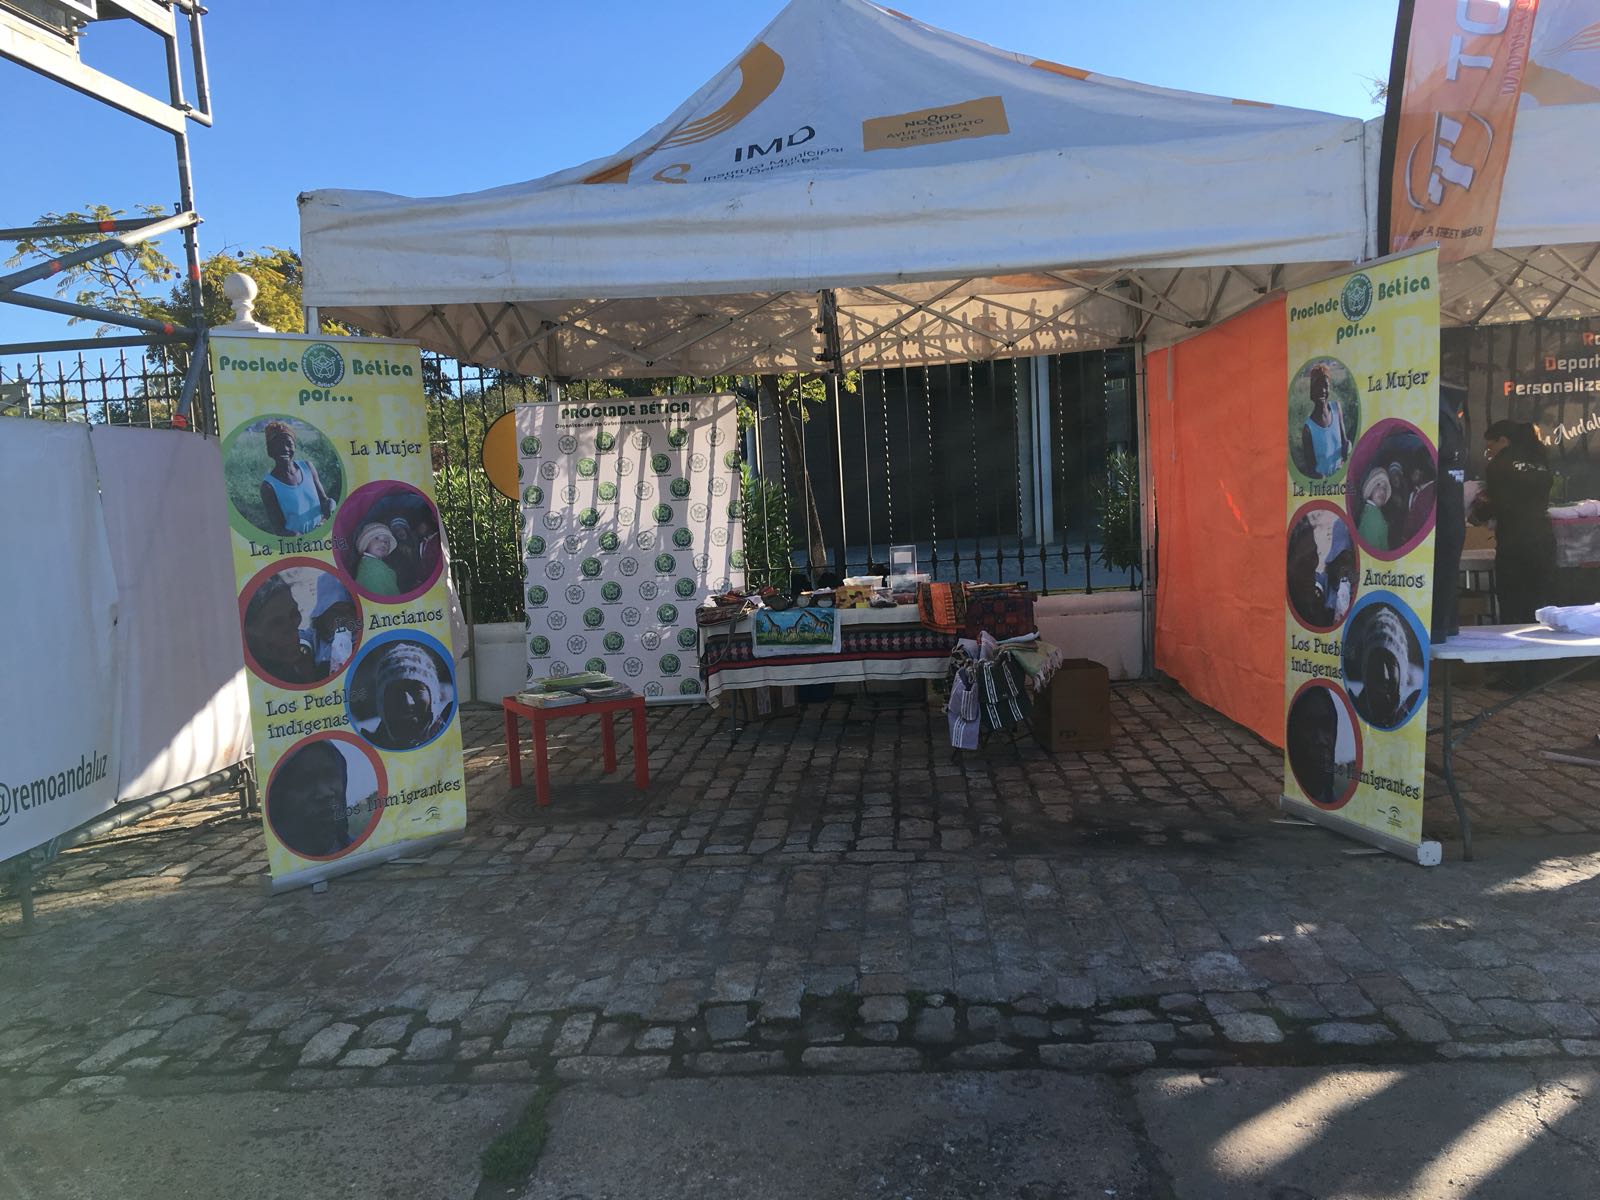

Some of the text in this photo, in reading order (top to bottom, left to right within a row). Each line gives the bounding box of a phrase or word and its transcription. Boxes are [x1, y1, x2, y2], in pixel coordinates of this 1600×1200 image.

[734, 125, 816, 162] IMD
[1291, 299, 1339, 321] Proclade
[1378, 275, 1430, 301] Bética
[1337, 324, 1376, 344] por...
[219, 356, 298, 373] Proclade
[352, 358, 413, 377] Bética
[1368, 370, 1429, 392] La Mujer
[299, 388, 353, 405] por...
[561, 401, 689, 419] PROCLADE BÉTICA
[350, 440, 421, 457] La Mujer
[1293, 481, 1305, 497] La
[250, 536, 348, 557] La Infancia
[1363, 570, 1424, 588] Ancianos
[369, 608, 443, 630] Ancianos
[1292, 635, 1309, 652] Los
[1291, 656, 1343, 679] indígenas
[266, 699, 297, 717] Los
[267, 713, 350, 739] indígenas
[366, 779, 461, 812] Inmigrantes
